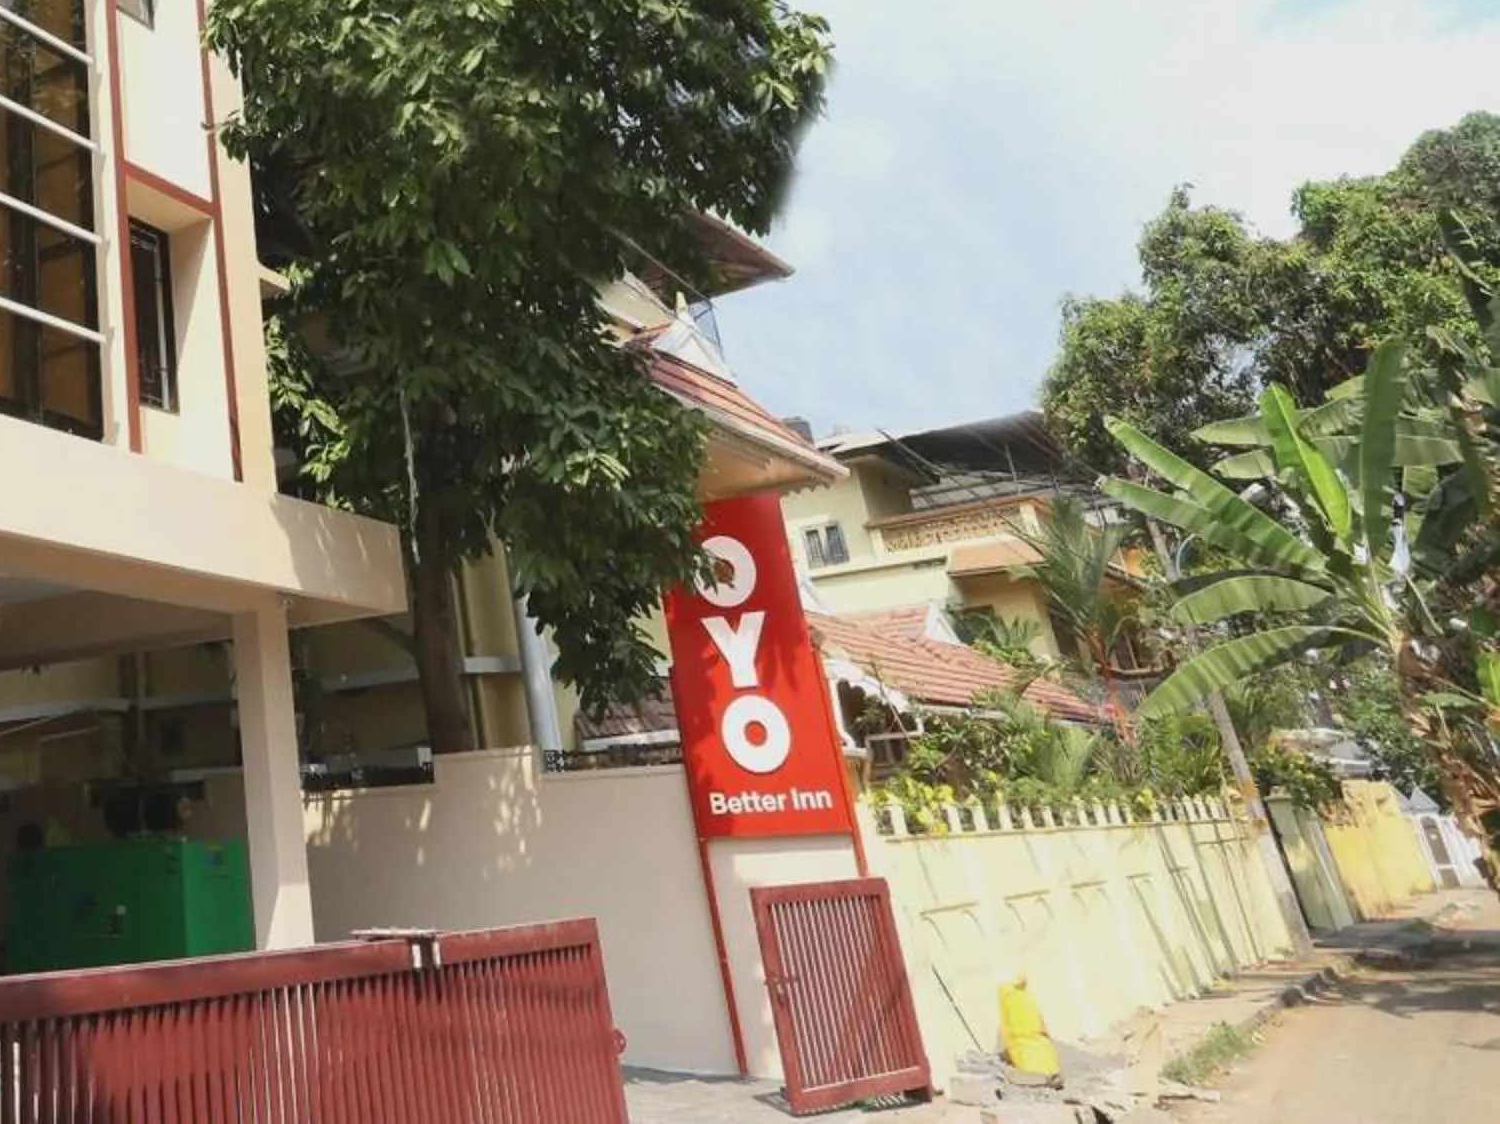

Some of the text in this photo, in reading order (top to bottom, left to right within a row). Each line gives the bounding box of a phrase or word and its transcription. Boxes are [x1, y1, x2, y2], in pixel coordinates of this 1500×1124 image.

[694, 535, 791, 773] OYO
[709, 787, 833, 814] Better Inn
